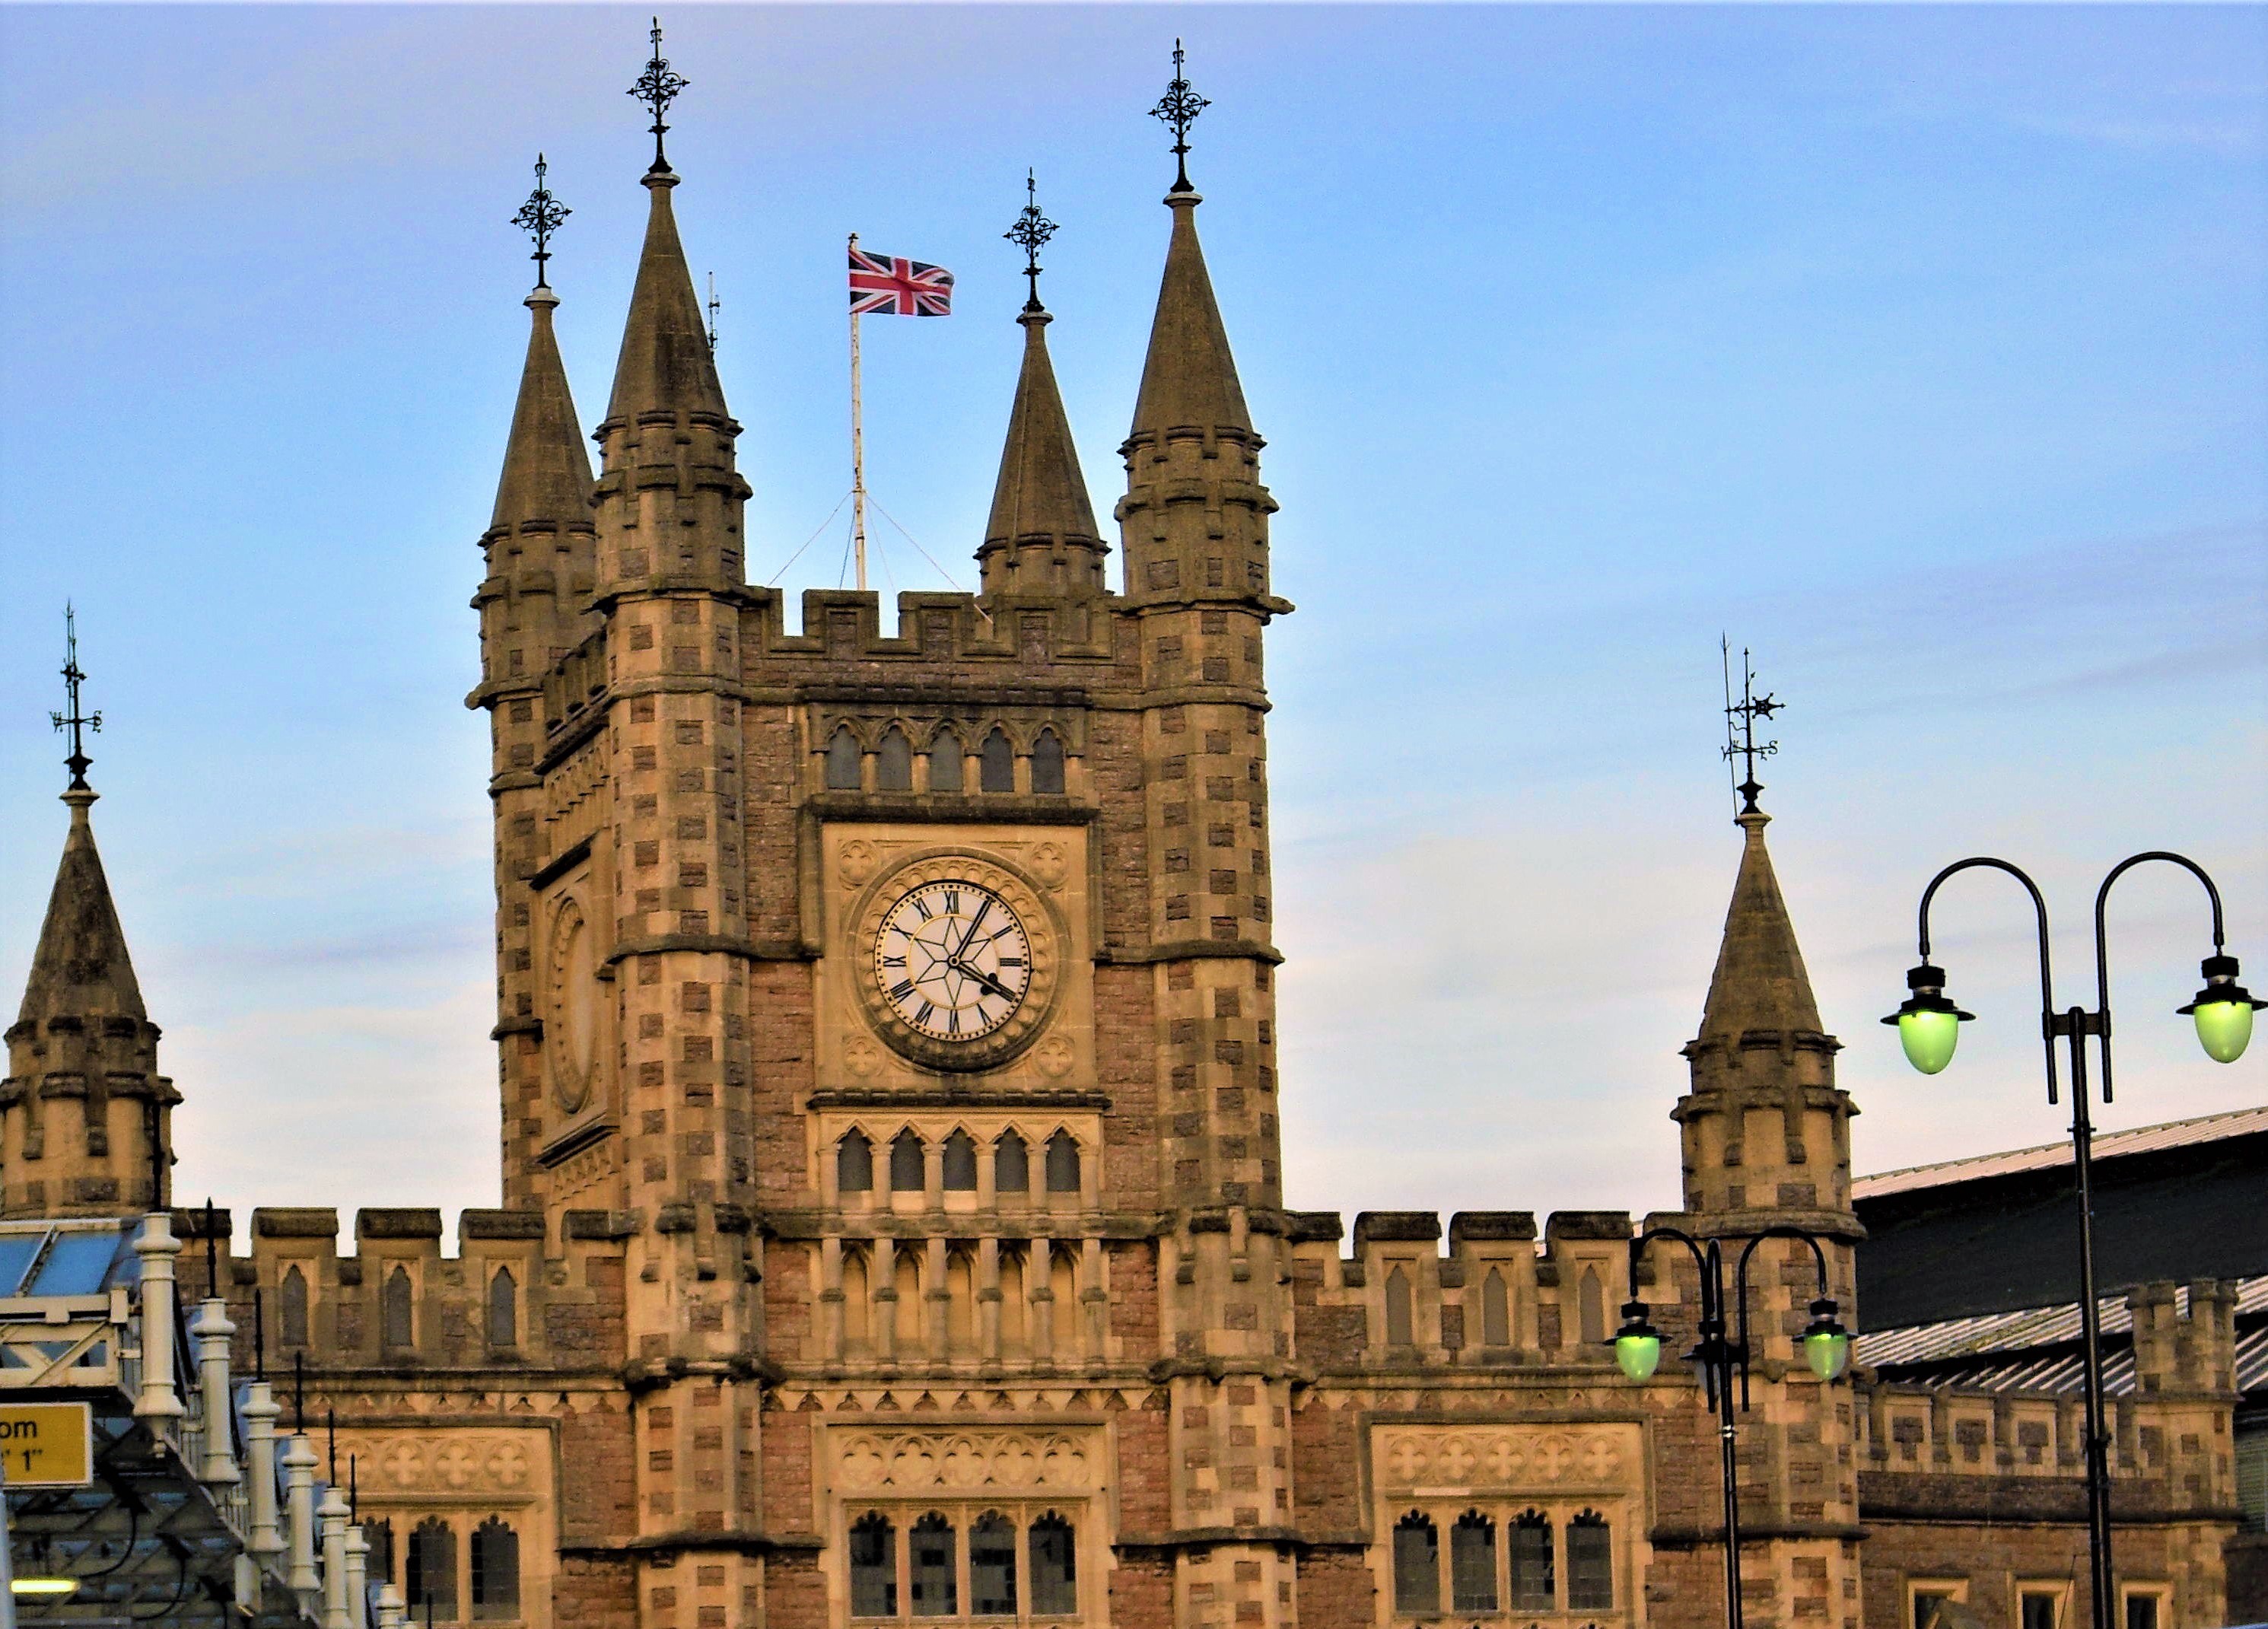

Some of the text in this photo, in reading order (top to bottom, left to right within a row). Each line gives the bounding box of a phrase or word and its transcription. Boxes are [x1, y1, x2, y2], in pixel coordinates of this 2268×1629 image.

[911, 897, 933, 923] XI
[889, 923, 914, 941] X
[883, 955, 906, 967] IX
[977, 1003, 993, 1026] V
